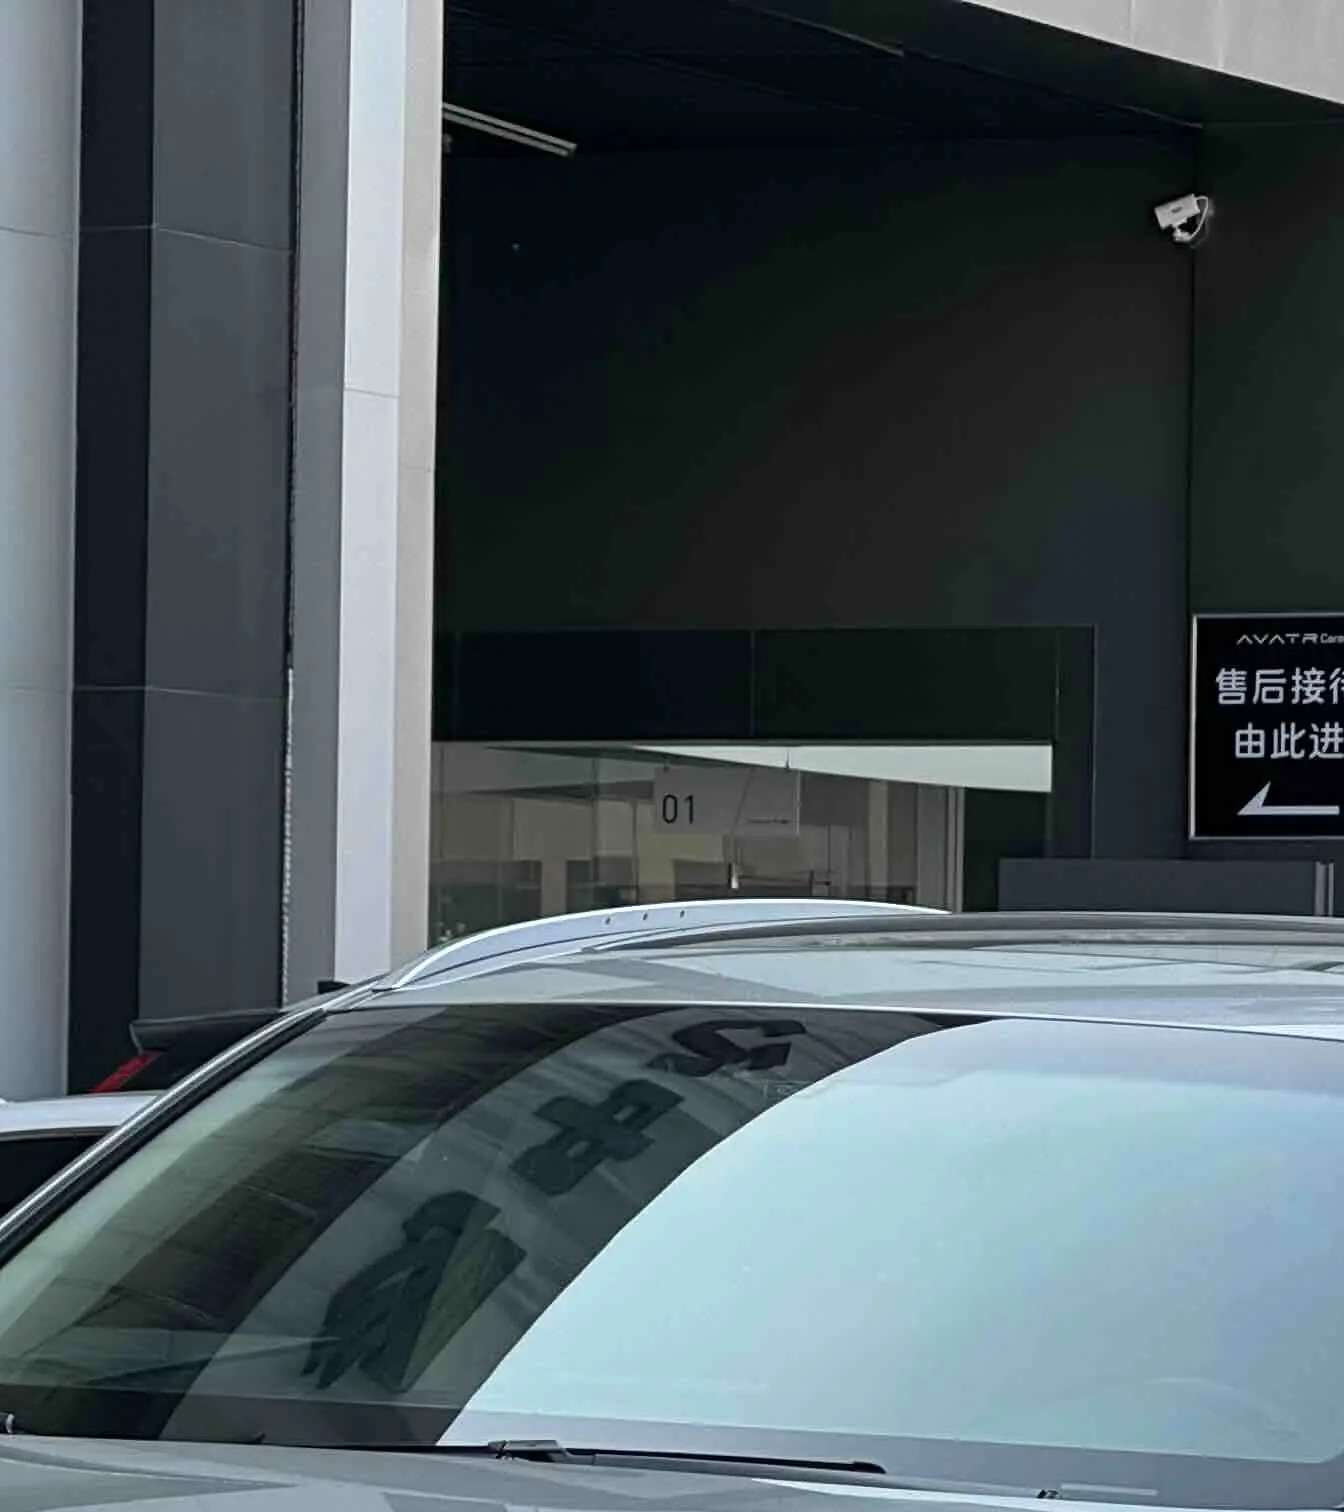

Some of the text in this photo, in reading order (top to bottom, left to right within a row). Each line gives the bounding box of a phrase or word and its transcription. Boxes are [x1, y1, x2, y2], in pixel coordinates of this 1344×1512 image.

[1236, 632, 1318, 645] AVATR
[1234, 721, 1344, 760] 由此进
[662, 794, 695, 824] 01
